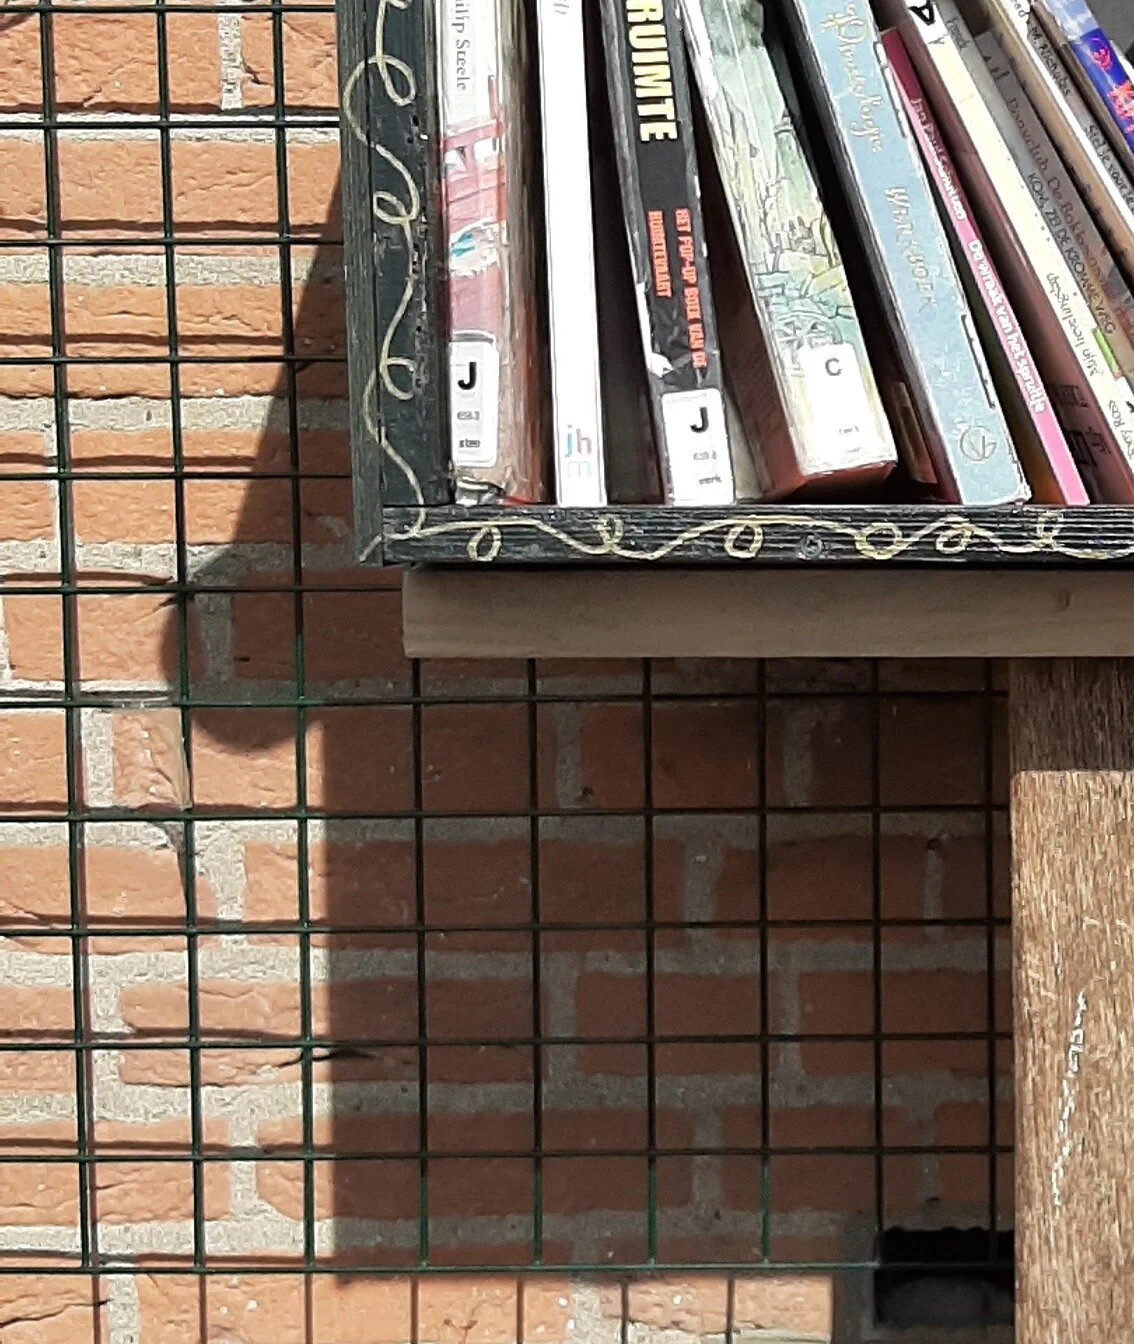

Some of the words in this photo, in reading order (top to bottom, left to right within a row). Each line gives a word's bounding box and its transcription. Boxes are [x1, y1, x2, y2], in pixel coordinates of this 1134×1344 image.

[455, 39, 473, 90] Steele
[993, 304, 1014, 334] van
[1004, 330, 1027, 360] het
[457, 361, 477, 390] J
[825, 357, 842, 376] C
[1009, 356, 1048, 416] spruitje
[689, 406, 709, 433] J
